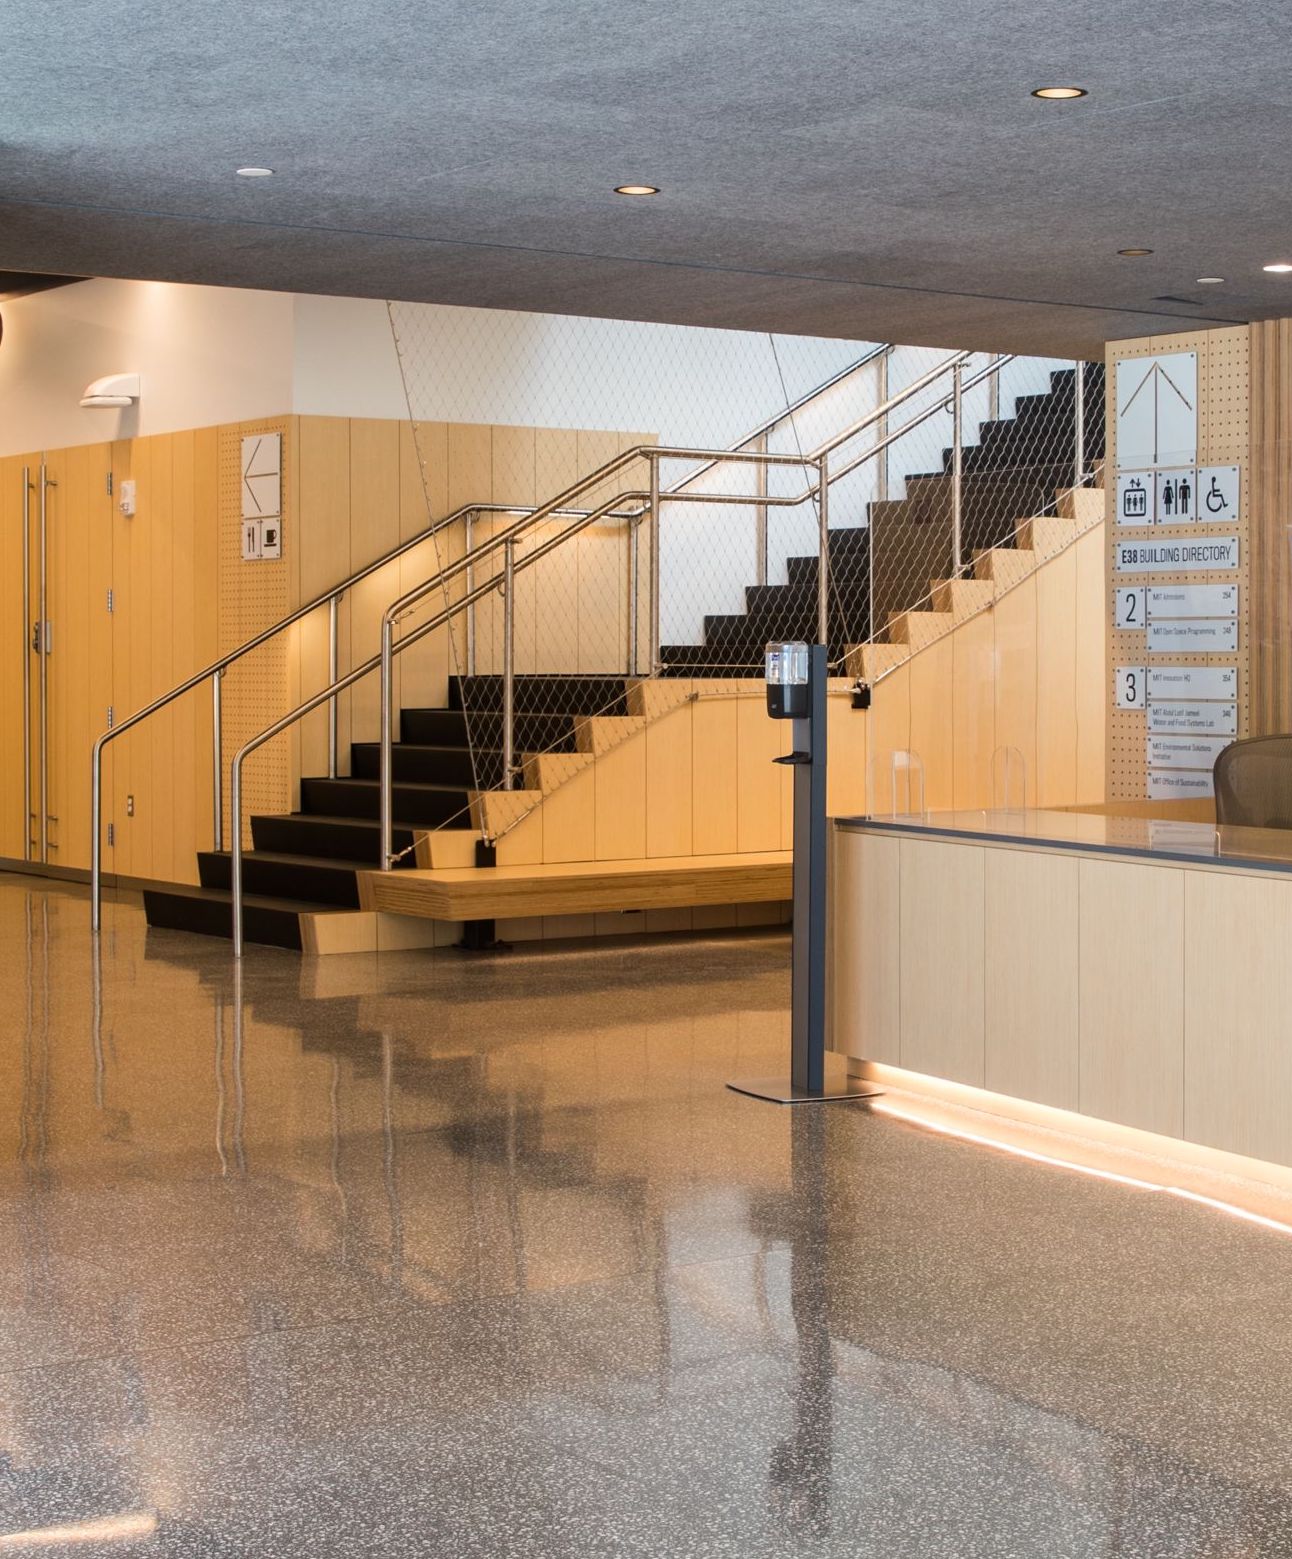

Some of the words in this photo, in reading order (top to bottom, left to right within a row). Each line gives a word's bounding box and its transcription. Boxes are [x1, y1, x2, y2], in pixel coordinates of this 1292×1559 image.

[1122, 549, 1138, 564] E38
[1139, 546, 1180, 563] BUILDING
[1182, 545, 1231, 562] DIRECTORY
[1125, 593, 1136, 622] 2
[1125, 673, 1136, 702] 3
